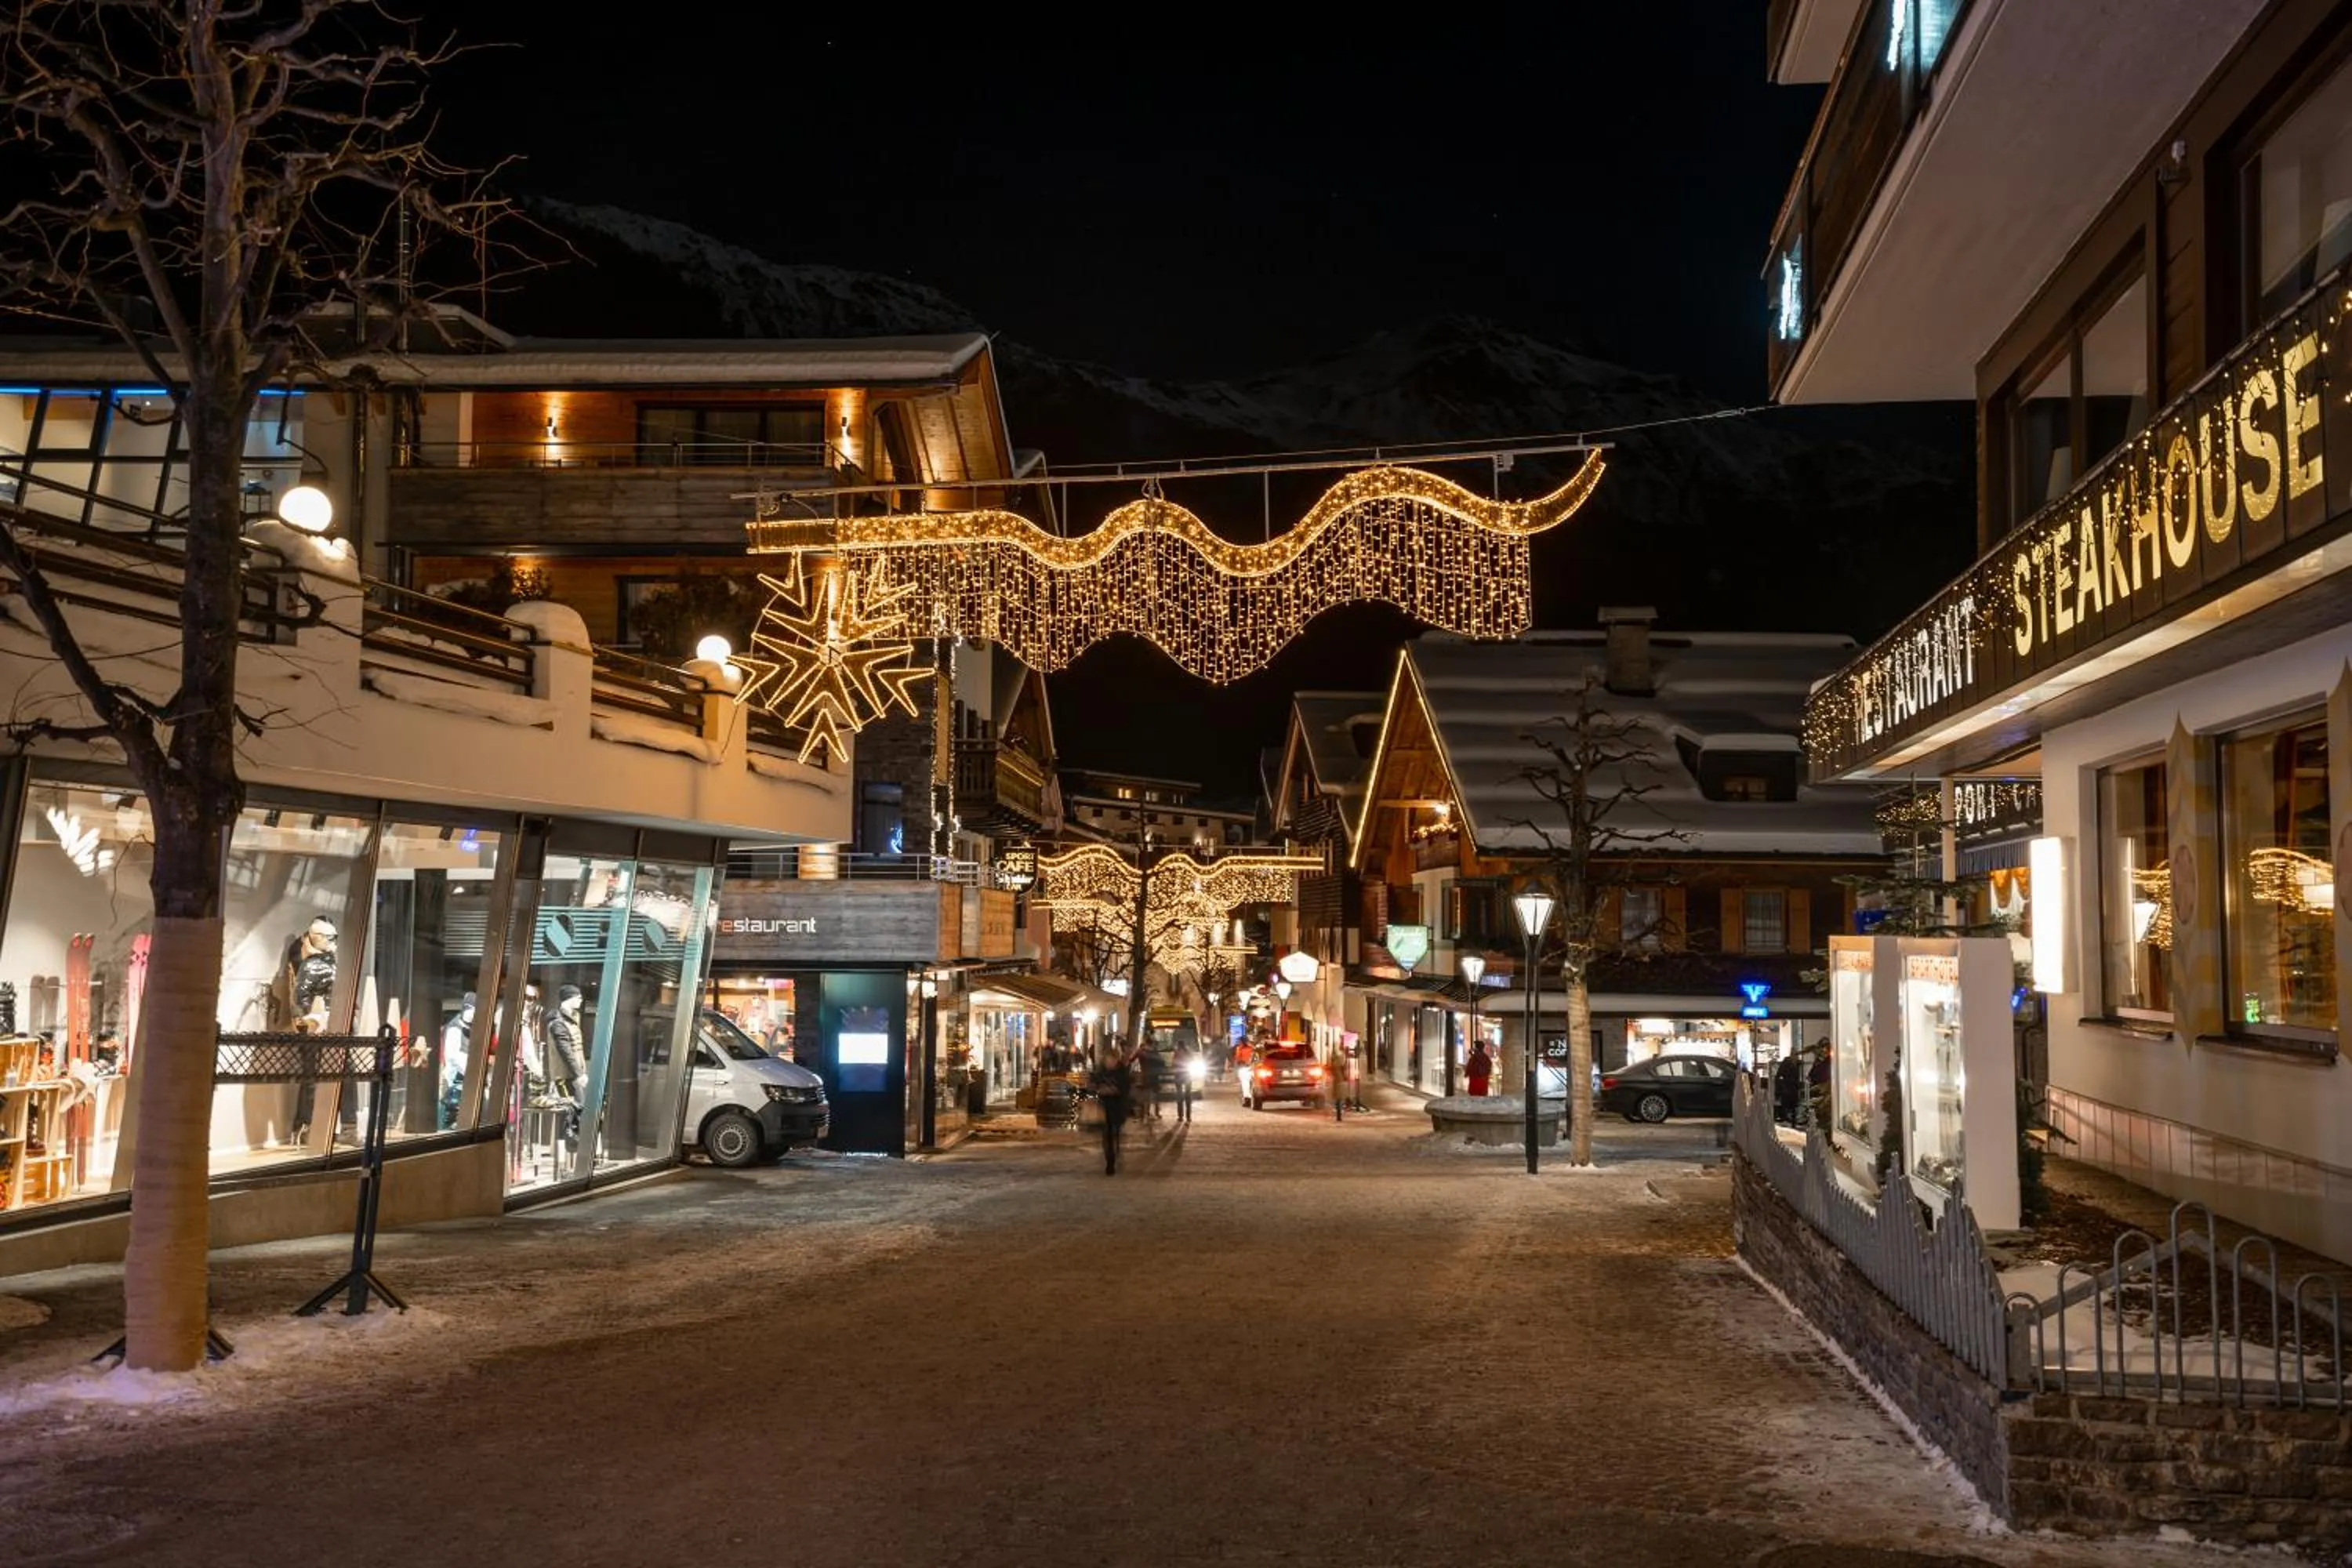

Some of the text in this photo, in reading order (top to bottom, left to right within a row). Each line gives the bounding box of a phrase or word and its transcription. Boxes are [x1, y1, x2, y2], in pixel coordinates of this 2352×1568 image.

[1853, 332, 2324, 746] RESTAURANT STEAKHOUSE
[996, 860, 1034, 872] CAFE
